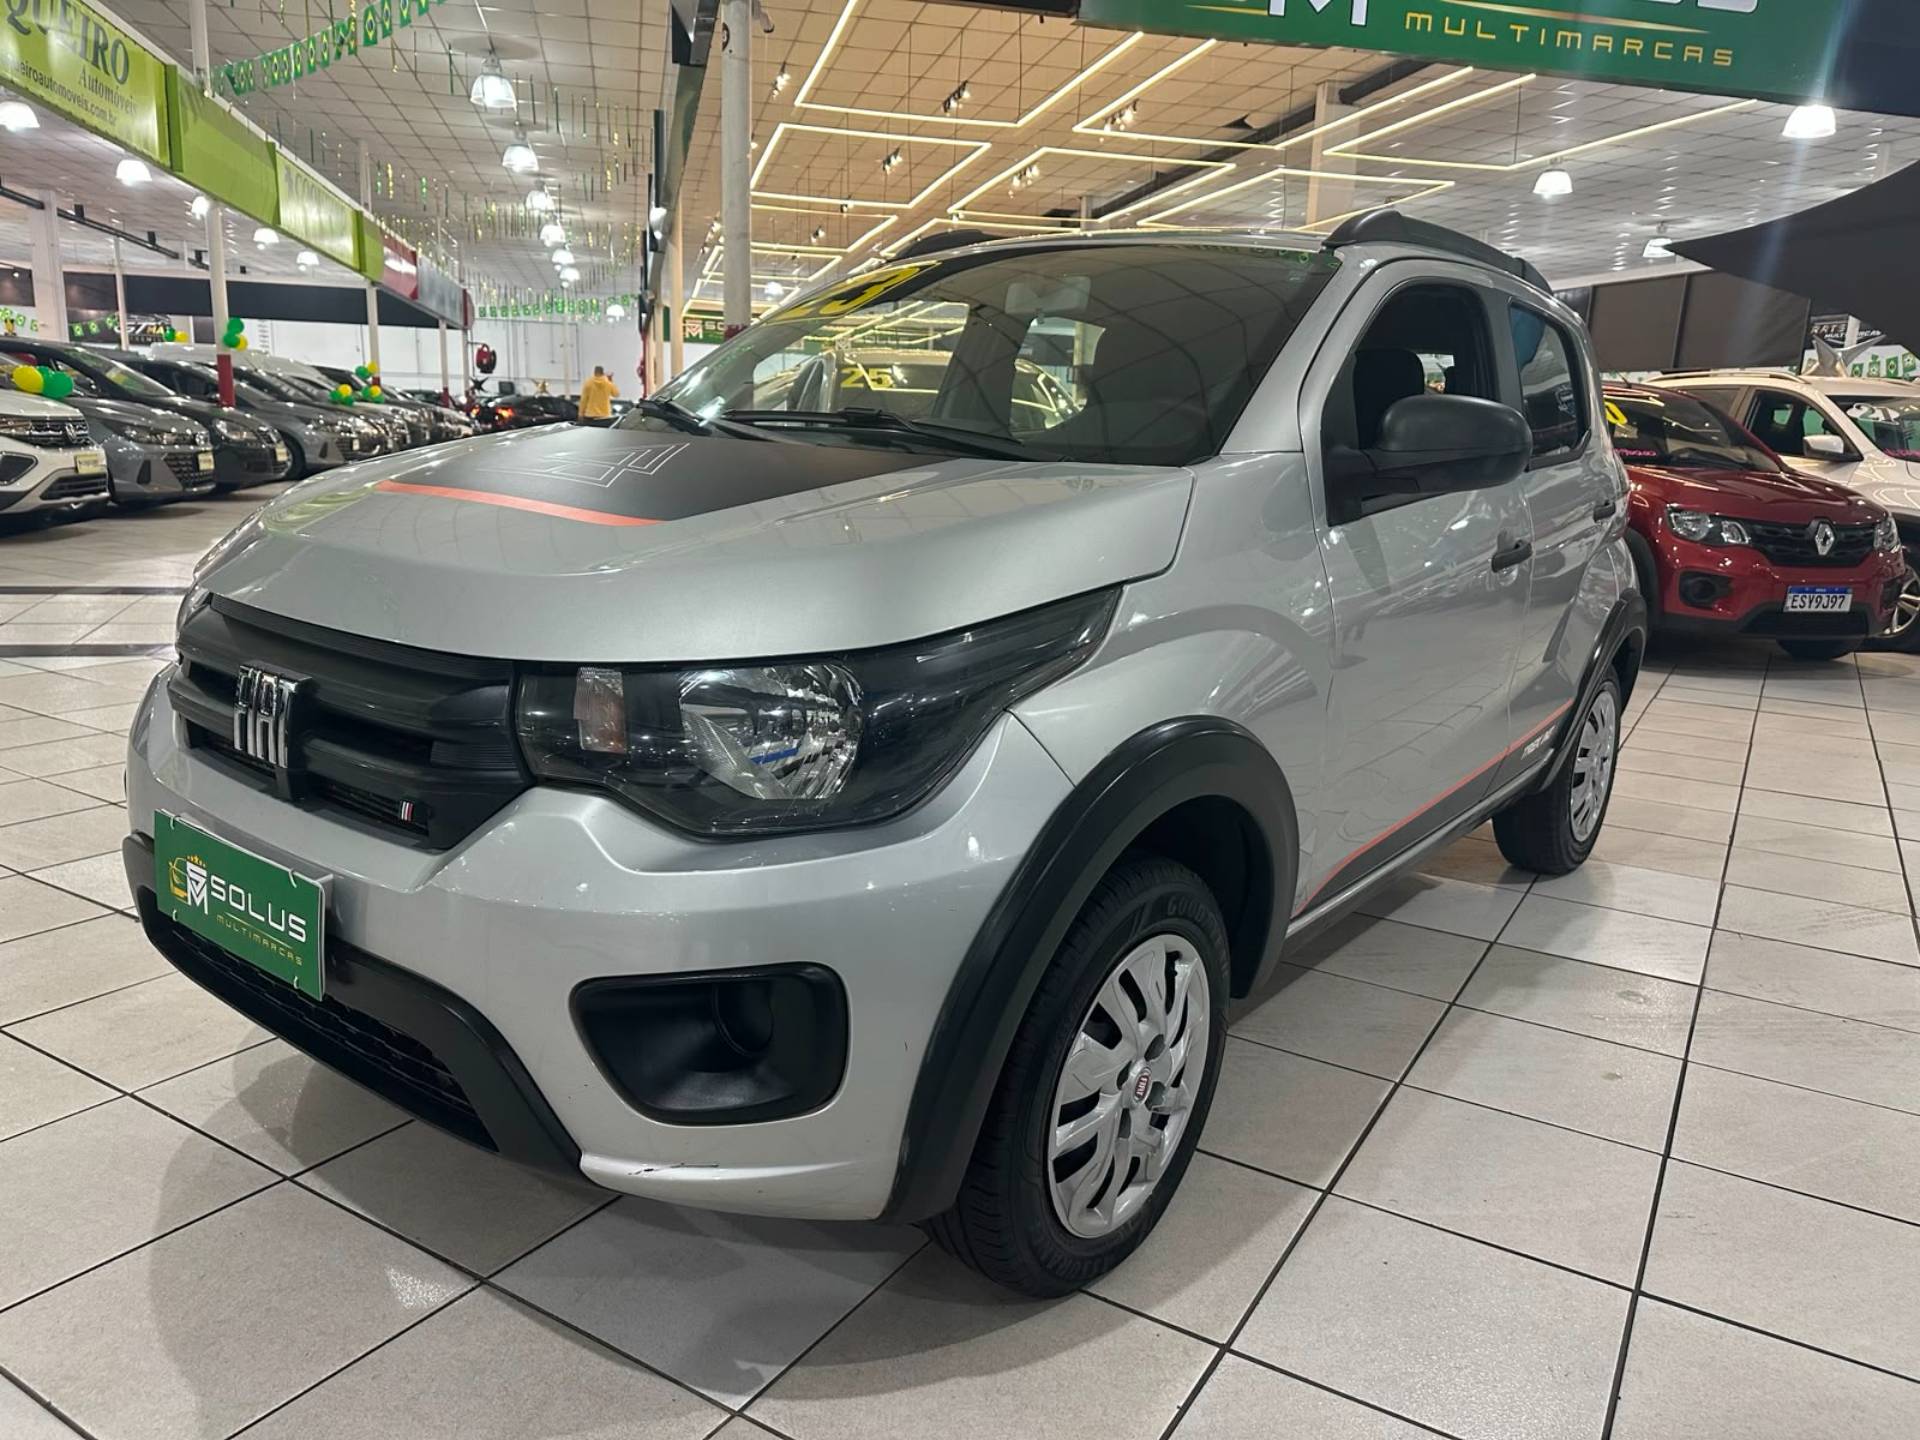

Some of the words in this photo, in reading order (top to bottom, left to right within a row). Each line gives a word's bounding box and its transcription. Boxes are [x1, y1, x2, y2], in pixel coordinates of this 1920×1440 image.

[1405, 11, 1734, 67] MULTIMARCAS
[1791, 594, 1846, 609] ESY9J97
[234, 665, 298, 769] FIAT
[210, 874, 307, 943] SOLUS
[216, 914, 303, 966] MULTIMARCAS
